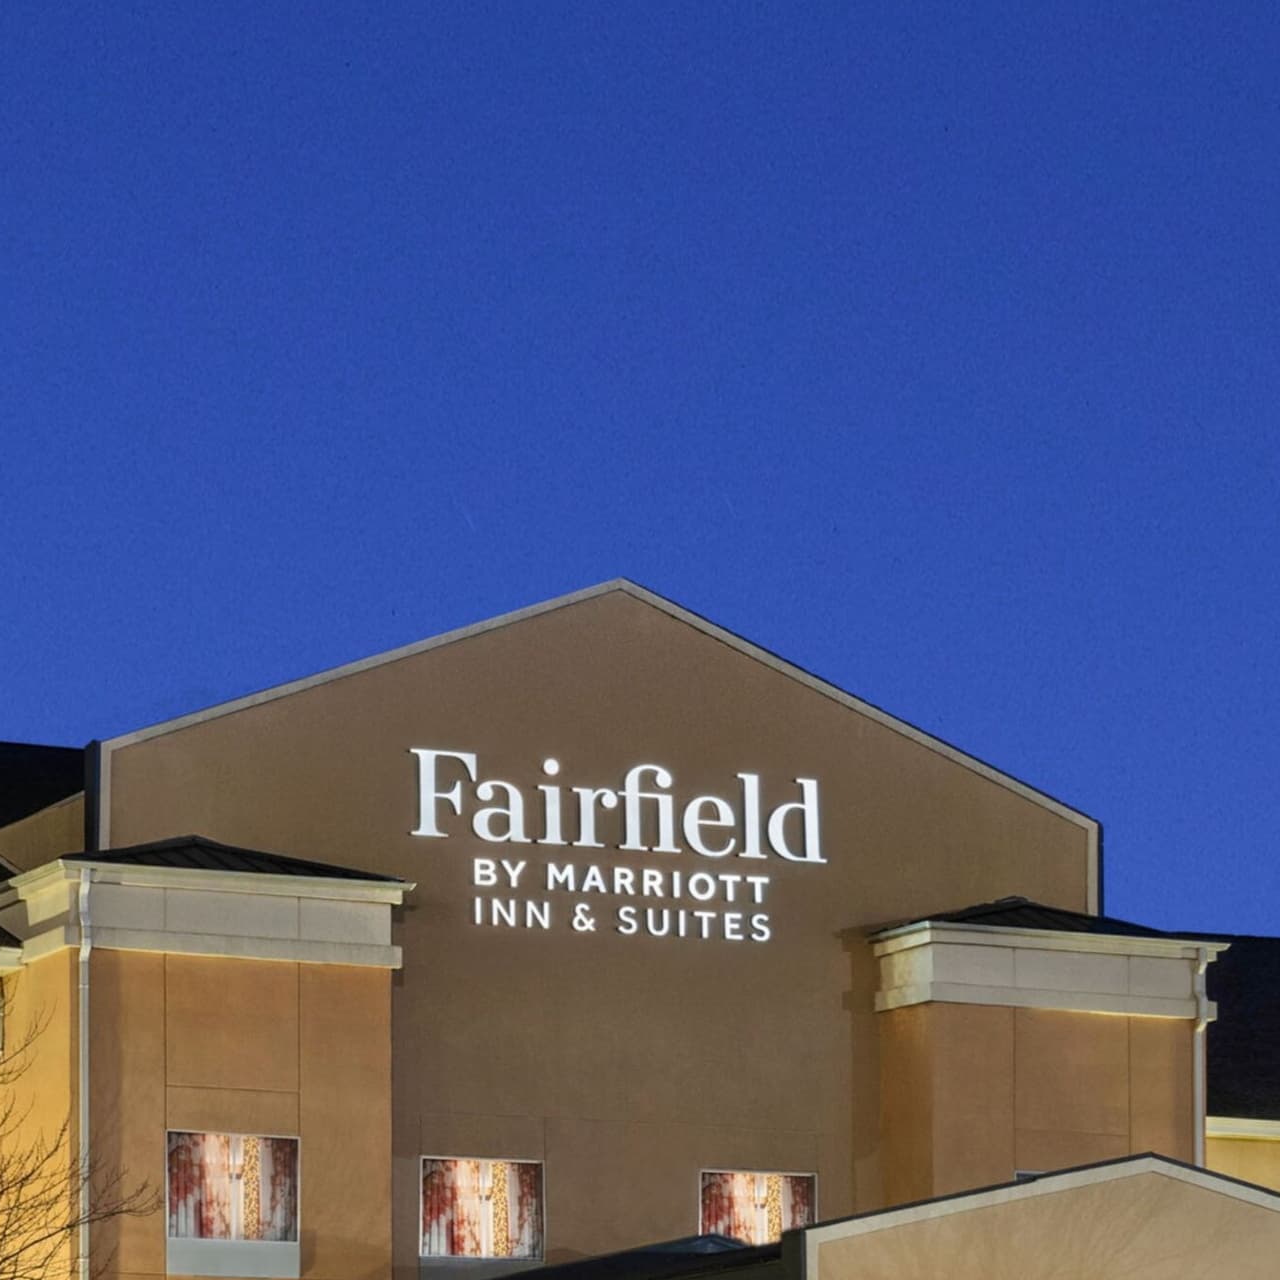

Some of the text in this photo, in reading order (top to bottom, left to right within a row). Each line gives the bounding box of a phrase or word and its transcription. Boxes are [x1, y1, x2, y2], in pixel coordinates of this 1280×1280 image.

[409, 747, 828, 864] Fairfield
[473, 858, 771, 904] BY MARRIOTT
[474, 895, 772, 943] INN & SUITES
